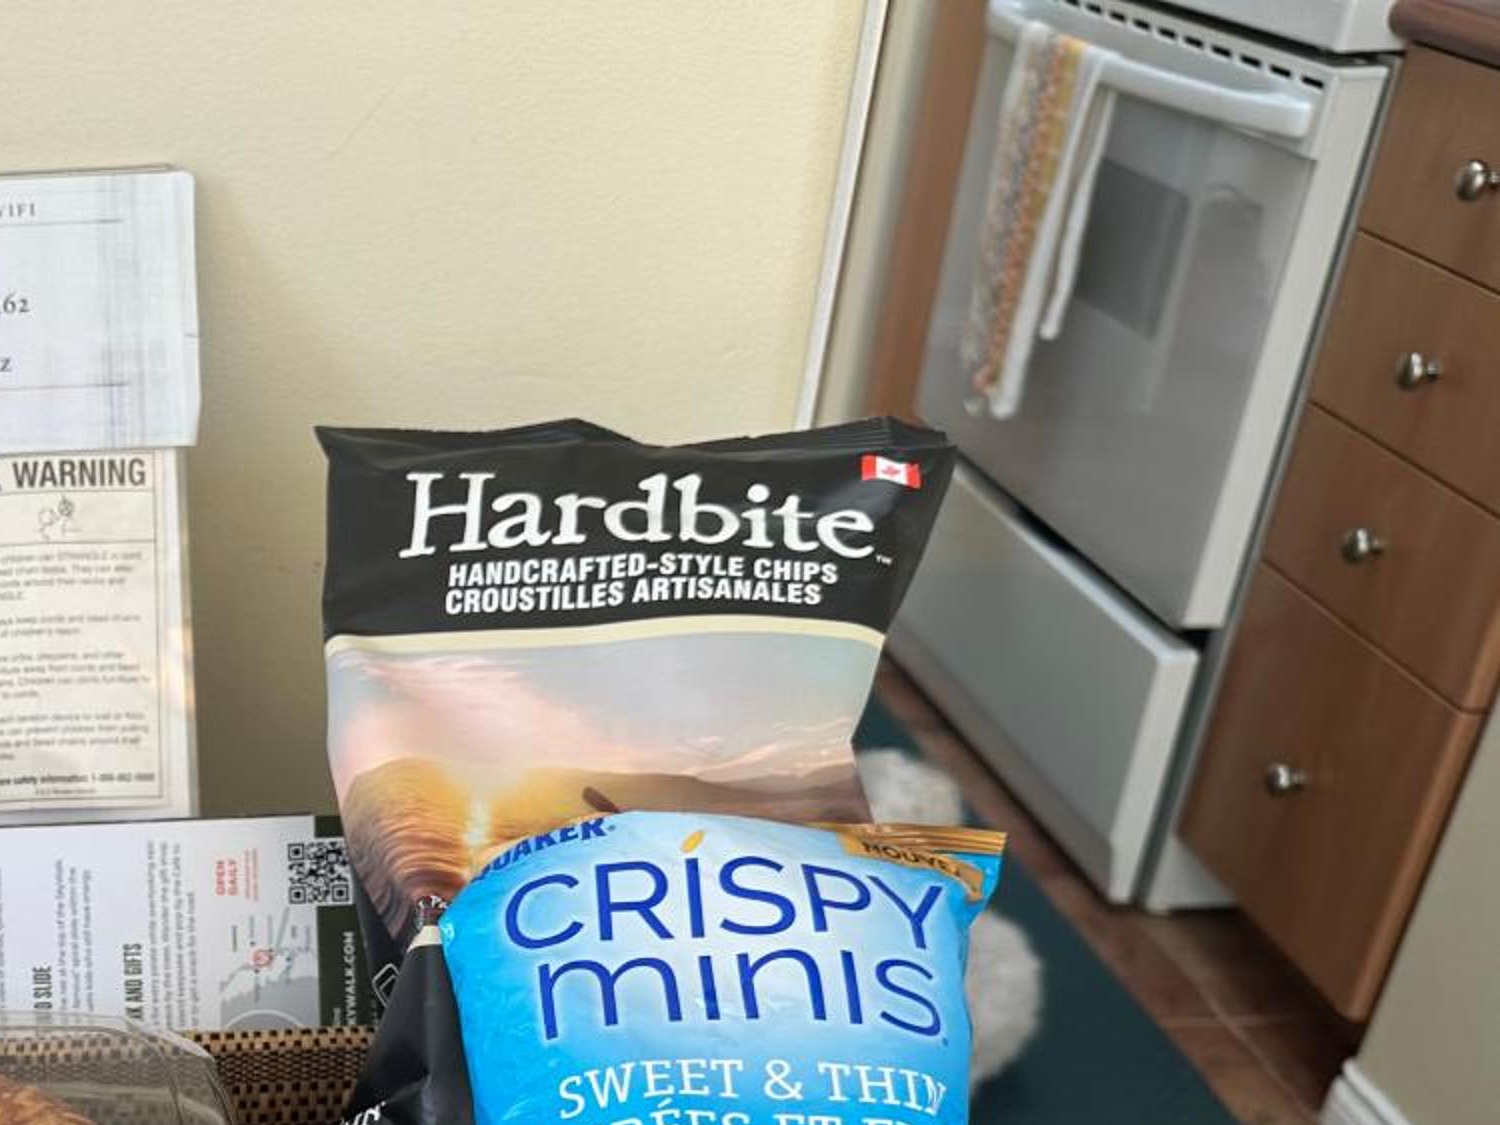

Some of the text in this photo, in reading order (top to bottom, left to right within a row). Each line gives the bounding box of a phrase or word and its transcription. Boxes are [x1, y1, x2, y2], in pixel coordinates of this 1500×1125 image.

[11, 457, 146, 489] WARNING
[398, 472, 876, 559] Hardbite
[448, 552, 839, 588] HANDCRAFTED-STYLE CHIPS
[445, 577, 823, 615] CROUSTILLES ARTISANALES
[504, 832, 944, 951] CRISPY
[122, 943, 142, 976] GIFTS
[32, 965, 52, 999] SLIDE
[124, 979, 143, 1002] AND
[537, 949, 943, 1042] minis
[558, 1059, 948, 1120] SWEET & THIN
